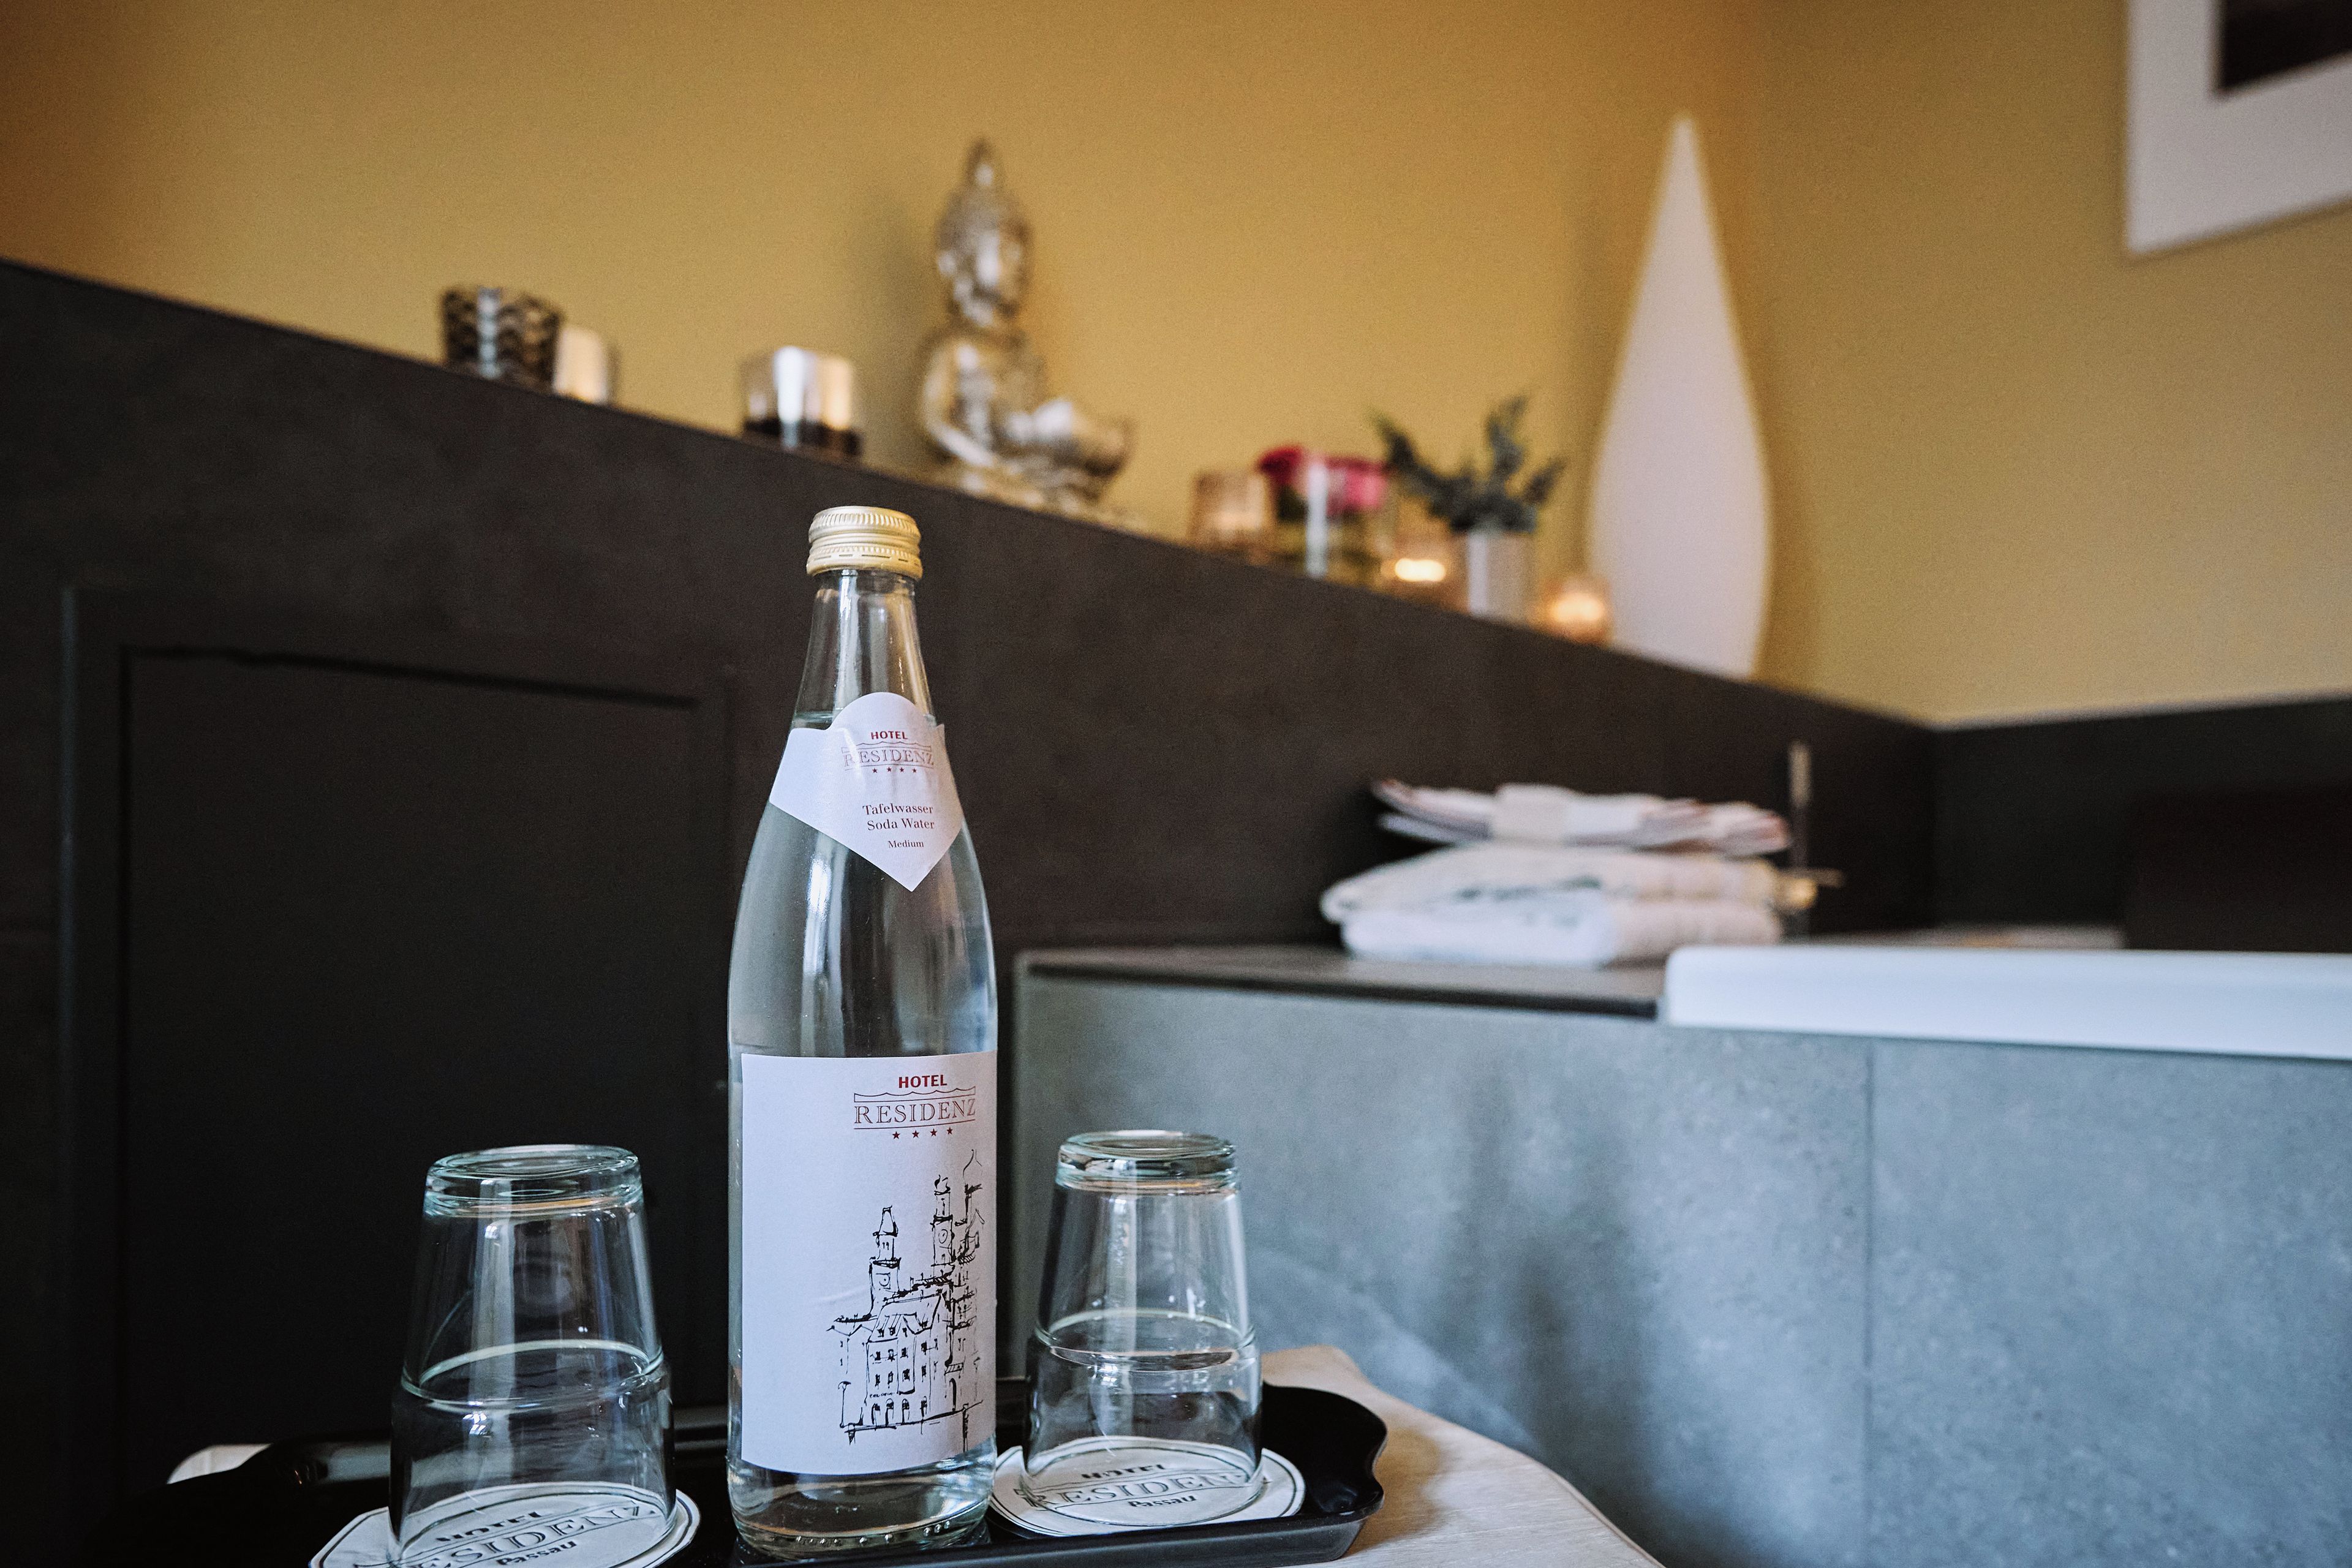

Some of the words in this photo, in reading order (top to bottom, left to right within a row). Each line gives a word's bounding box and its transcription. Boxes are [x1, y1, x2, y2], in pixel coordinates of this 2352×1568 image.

[870, 731, 908, 740] HOTEL
[862, 803, 933, 815] Tafelwasser
[867, 819, 898, 831] Soda
[900, 818, 935, 829] Water
[888, 840, 924, 848] Medium
[899, 1074, 948, 1088] HOTEL
[854, 1098, 976, 1124] RESIDENZ
[1128, 1495, 1197, 1507] Passau
[496, 1540, 577, 1566] Passau
